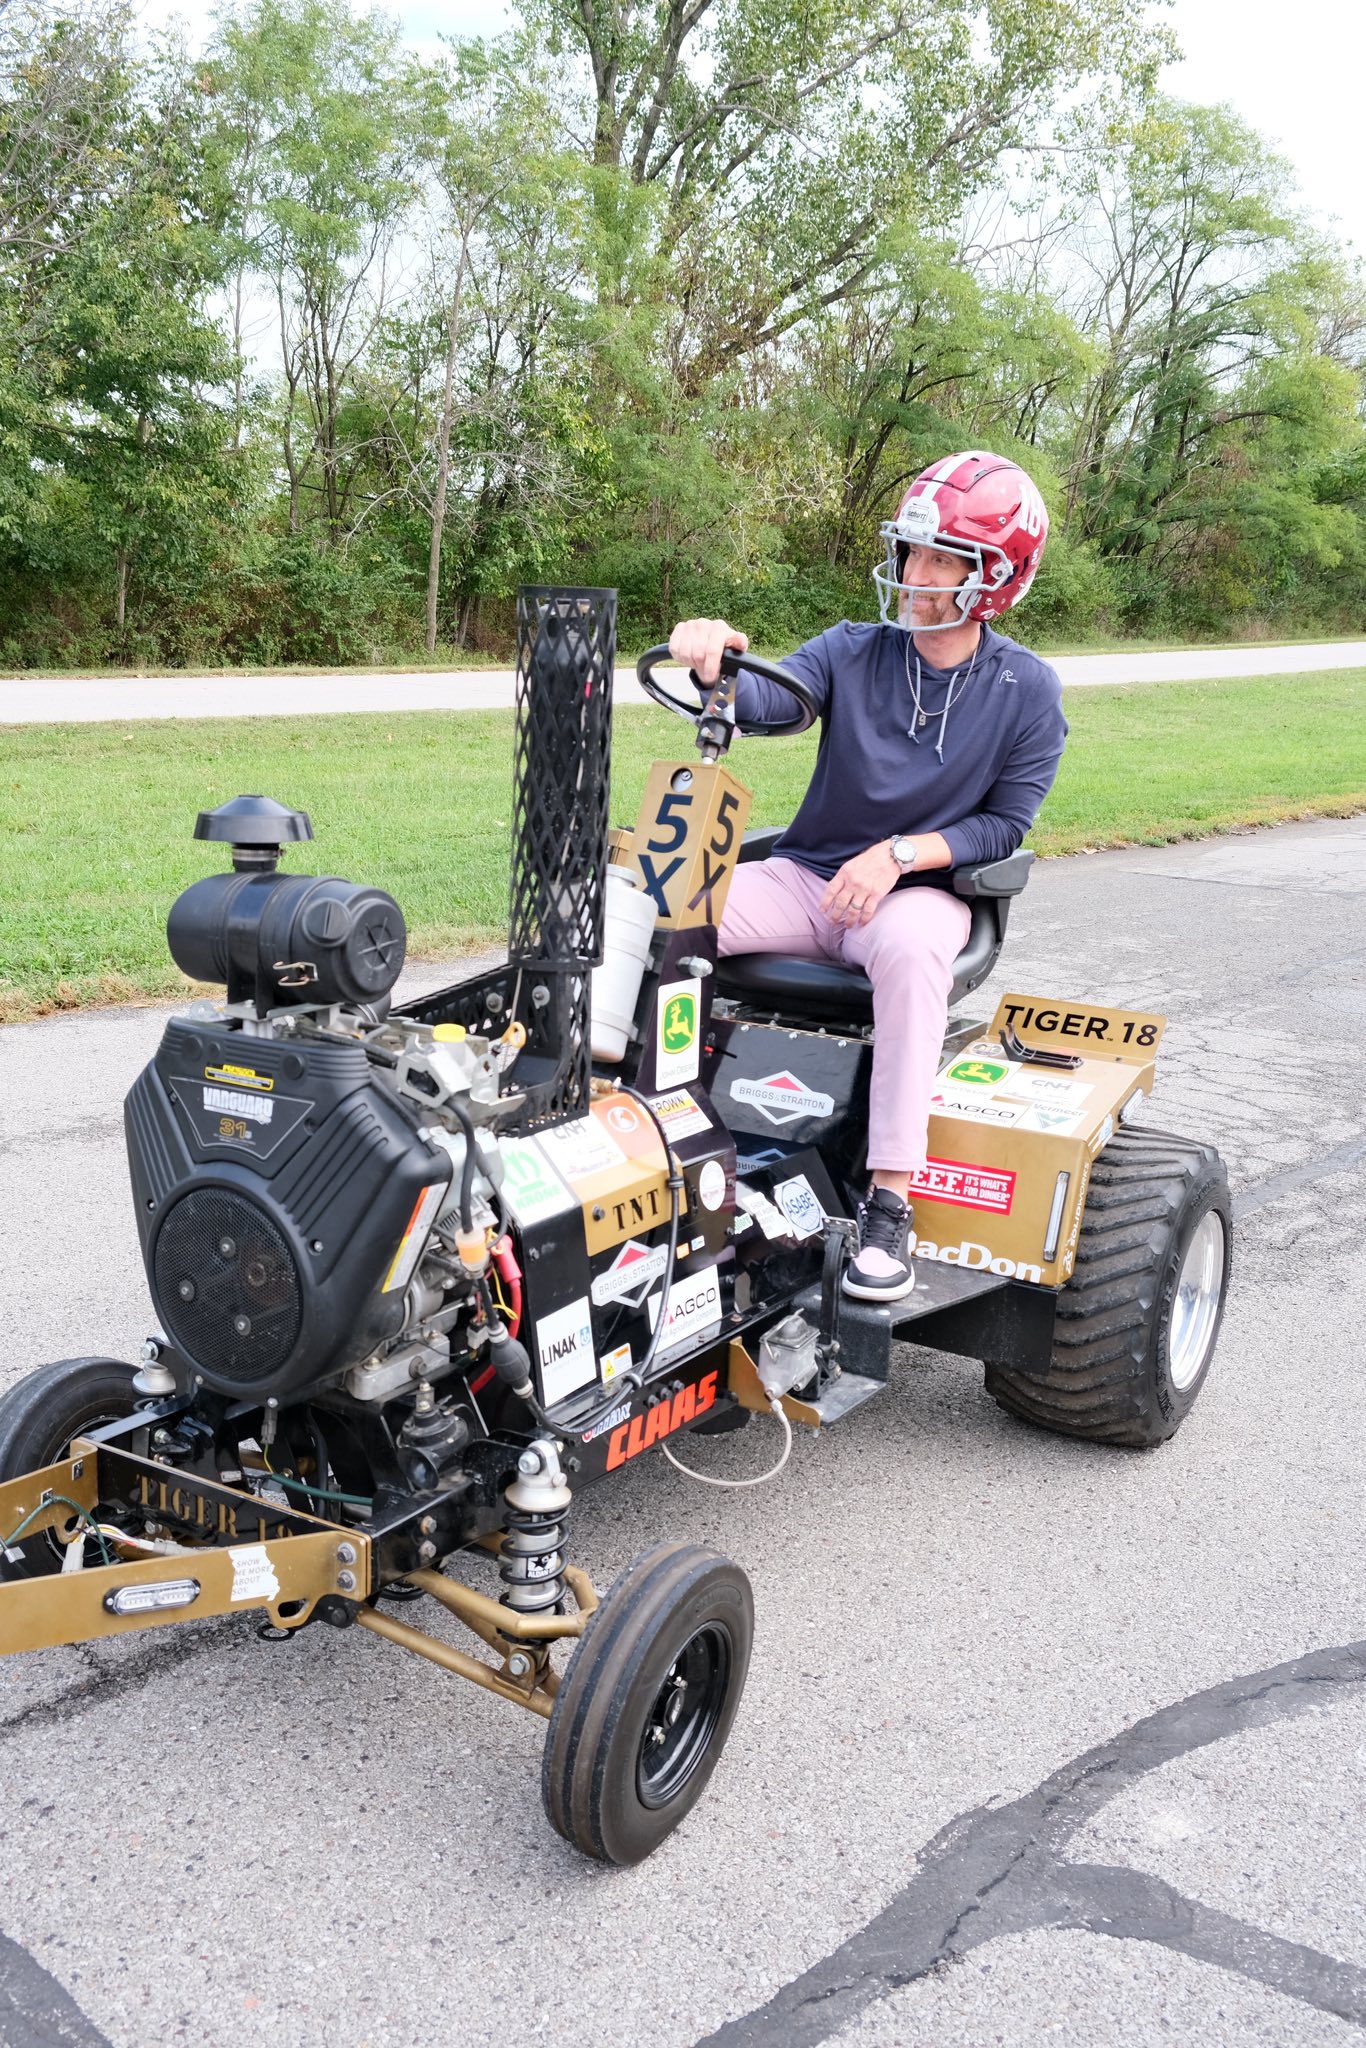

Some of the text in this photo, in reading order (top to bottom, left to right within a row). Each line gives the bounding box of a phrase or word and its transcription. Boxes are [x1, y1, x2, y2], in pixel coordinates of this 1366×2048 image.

[1004, 1004, 1110, 1041] TIGER
[1122, 1022, 1158, 1047] 18
[203, 1086, 274, 1118] VANGUARD
[739, 1086, 775, 1100] BRIGGS
[780, 1094, 826, 1110] STRATTON
[947, 1102, 1015, 1119] AGCO
[1033, 1103, 1085, 1117] Vermeer
[219, 1117, 247, 1140] 31
[910, 1167, 962, 1194] EEF.
[963, 1186, 978, 1198] FOR
[612, 1187, 660, 1231] TNT
[785, 1191, 815, 1216] ASABE
[598, 1274, 628, 1296] BRIGGS
[632, 1254, 667, 1279] STRATTON
[674, 1287, 717, 1319] AGCO
[541, 1332, 577, 1368] LINAK
[606, 1370, 719, 1472] CLAAS
[236, 1558, 260, 1568] SHOW
[248, 1565, 272, 1574] MORE
[234, 1575, 261, 1586] ABOUT
